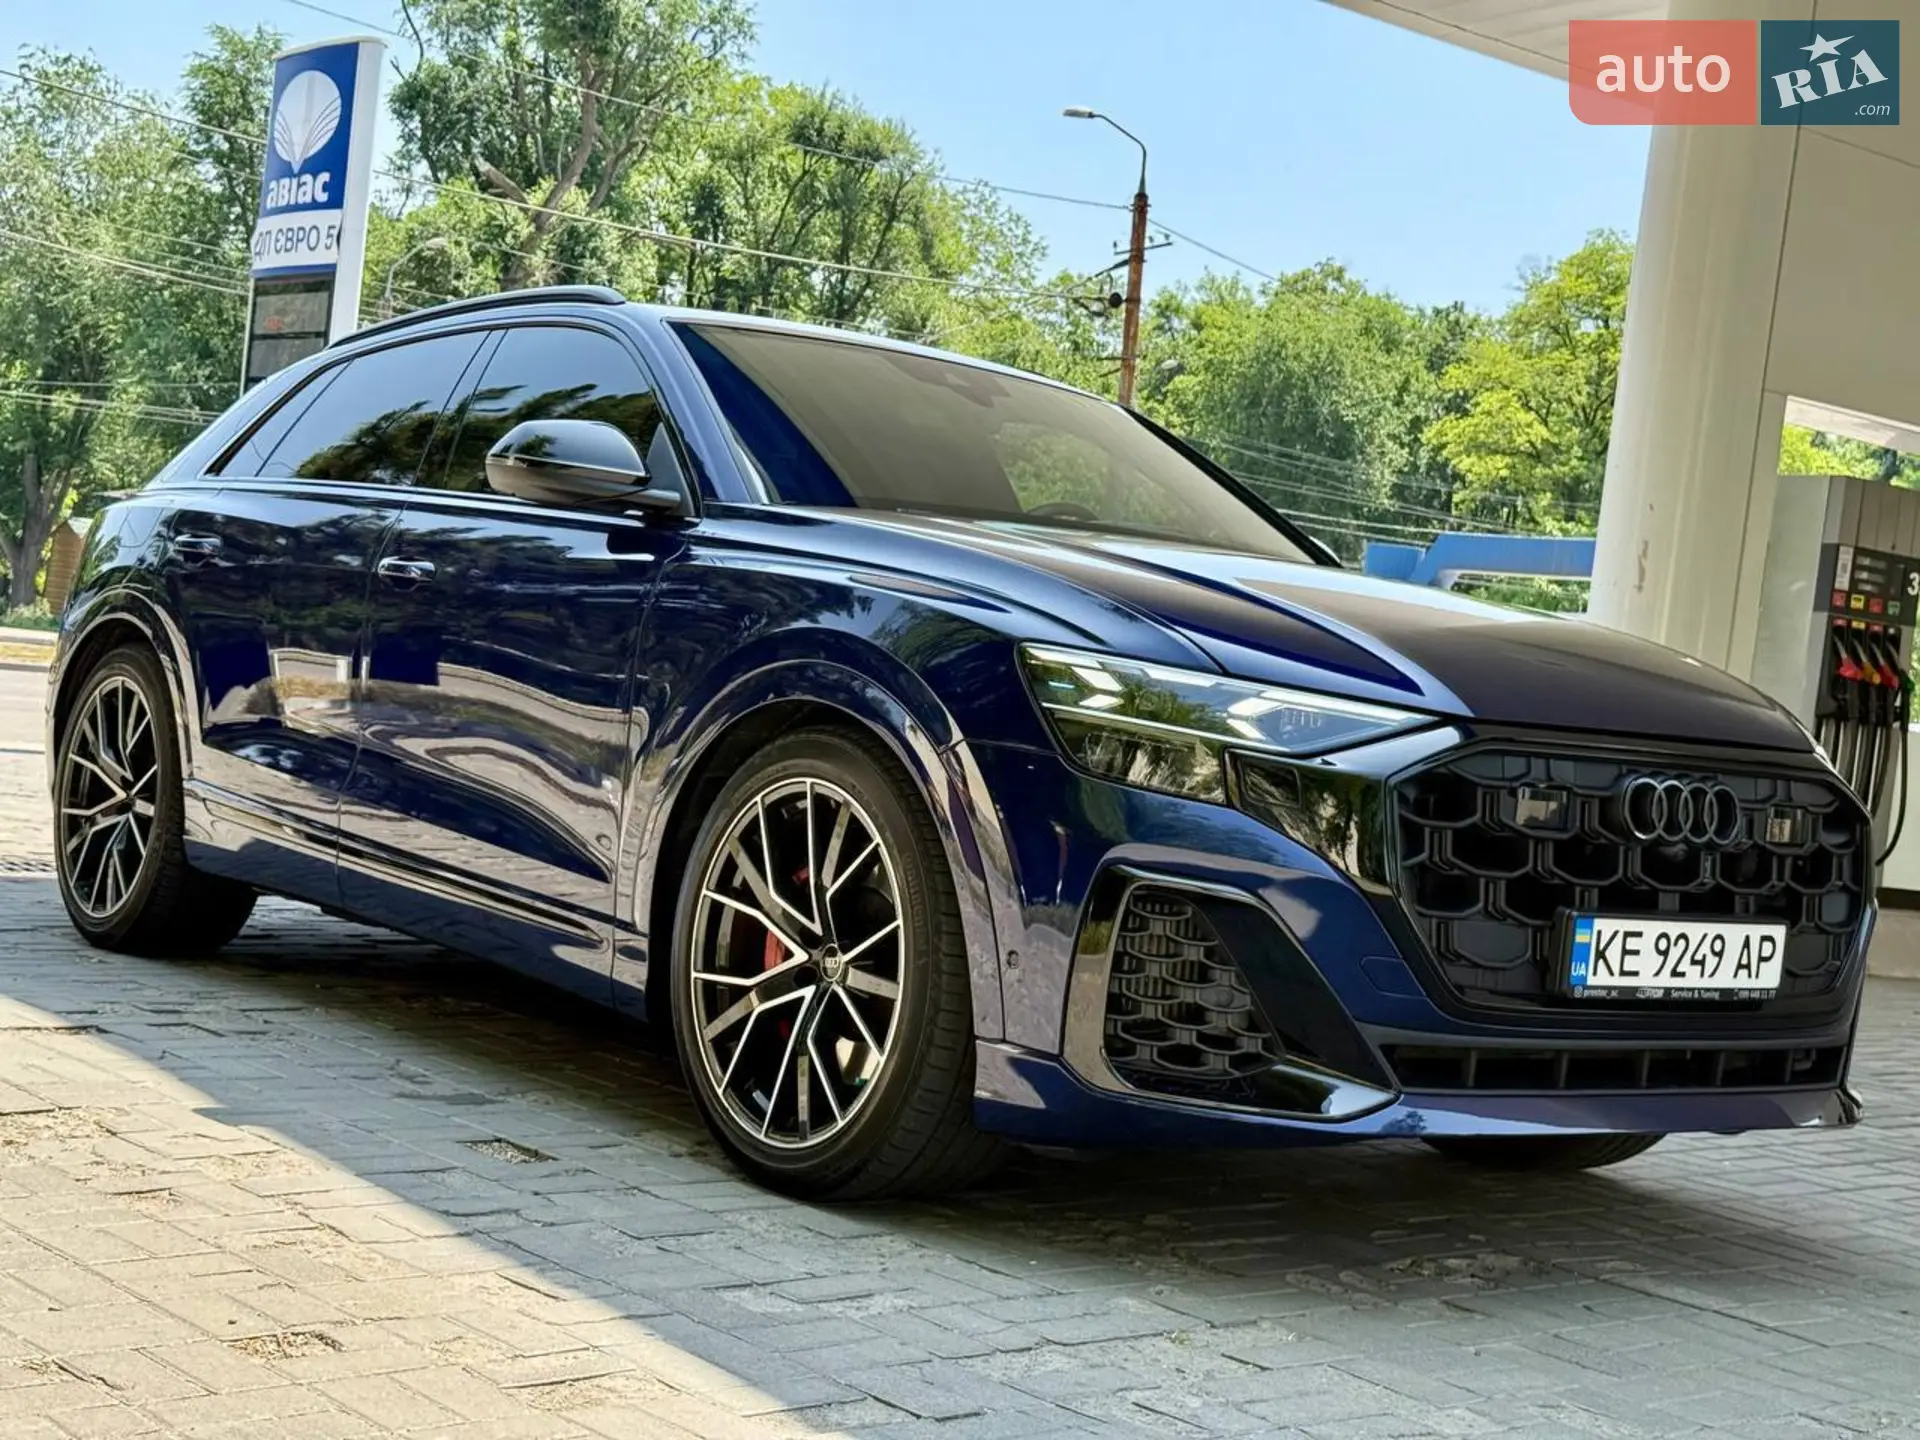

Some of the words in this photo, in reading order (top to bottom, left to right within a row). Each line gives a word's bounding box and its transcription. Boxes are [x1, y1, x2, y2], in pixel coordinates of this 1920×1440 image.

[274, 225, 320, 254] ЄВРО
[1907, 572, 1920, 596] 3
[1592, 929, 1644, 977] KE
[1652, 931, 1726, 979] 9249
[1733, 934, 1777, 979] AP
[1571, 961, 1587, 977] UA
